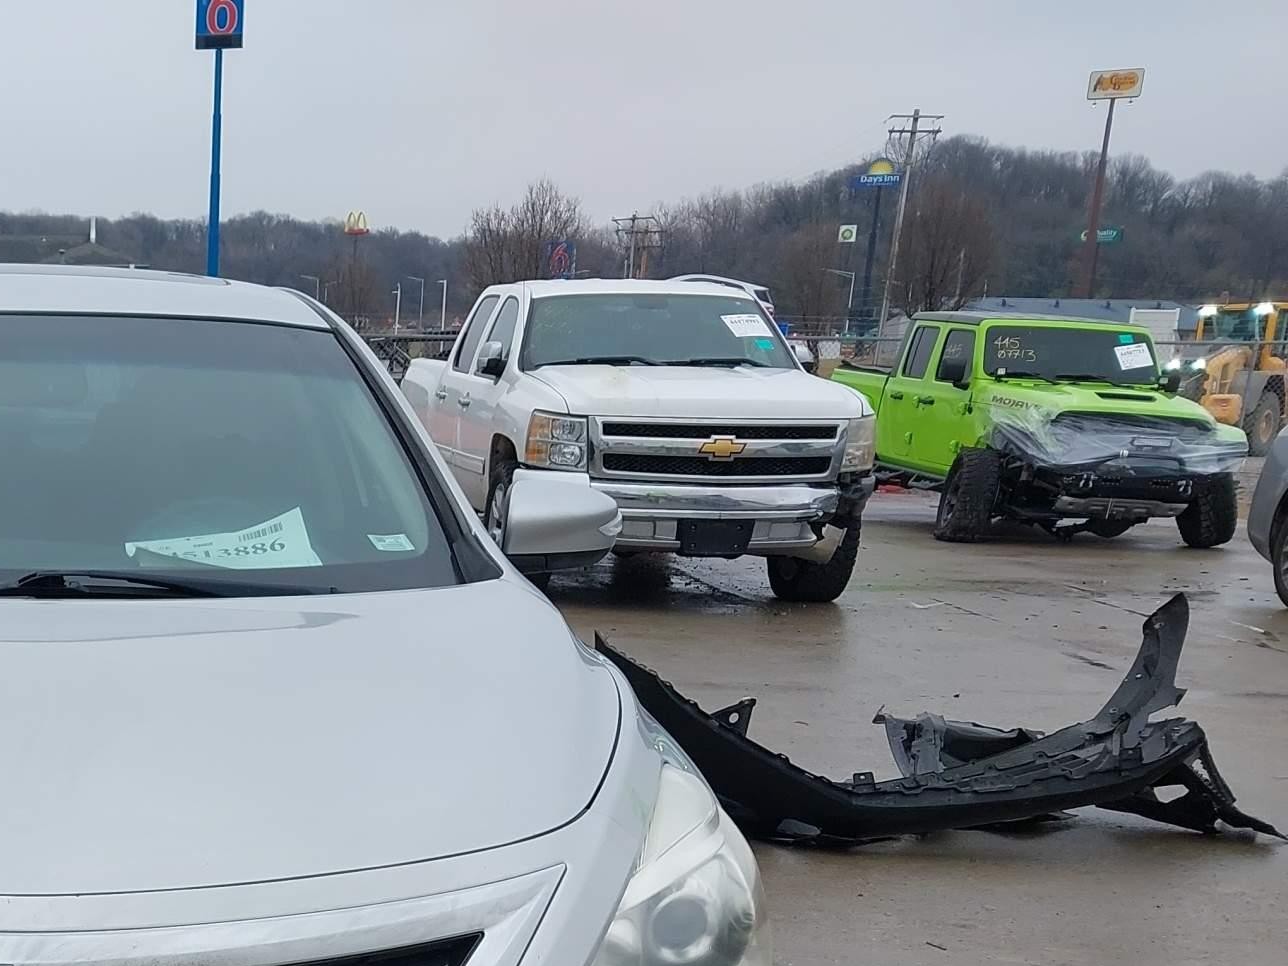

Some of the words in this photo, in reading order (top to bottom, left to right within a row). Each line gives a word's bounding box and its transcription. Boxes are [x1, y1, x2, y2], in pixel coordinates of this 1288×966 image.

[206, 0, 238, 35] 6
[860, 175, 883, 184] Days
[550, 242, 569, 274] 6
